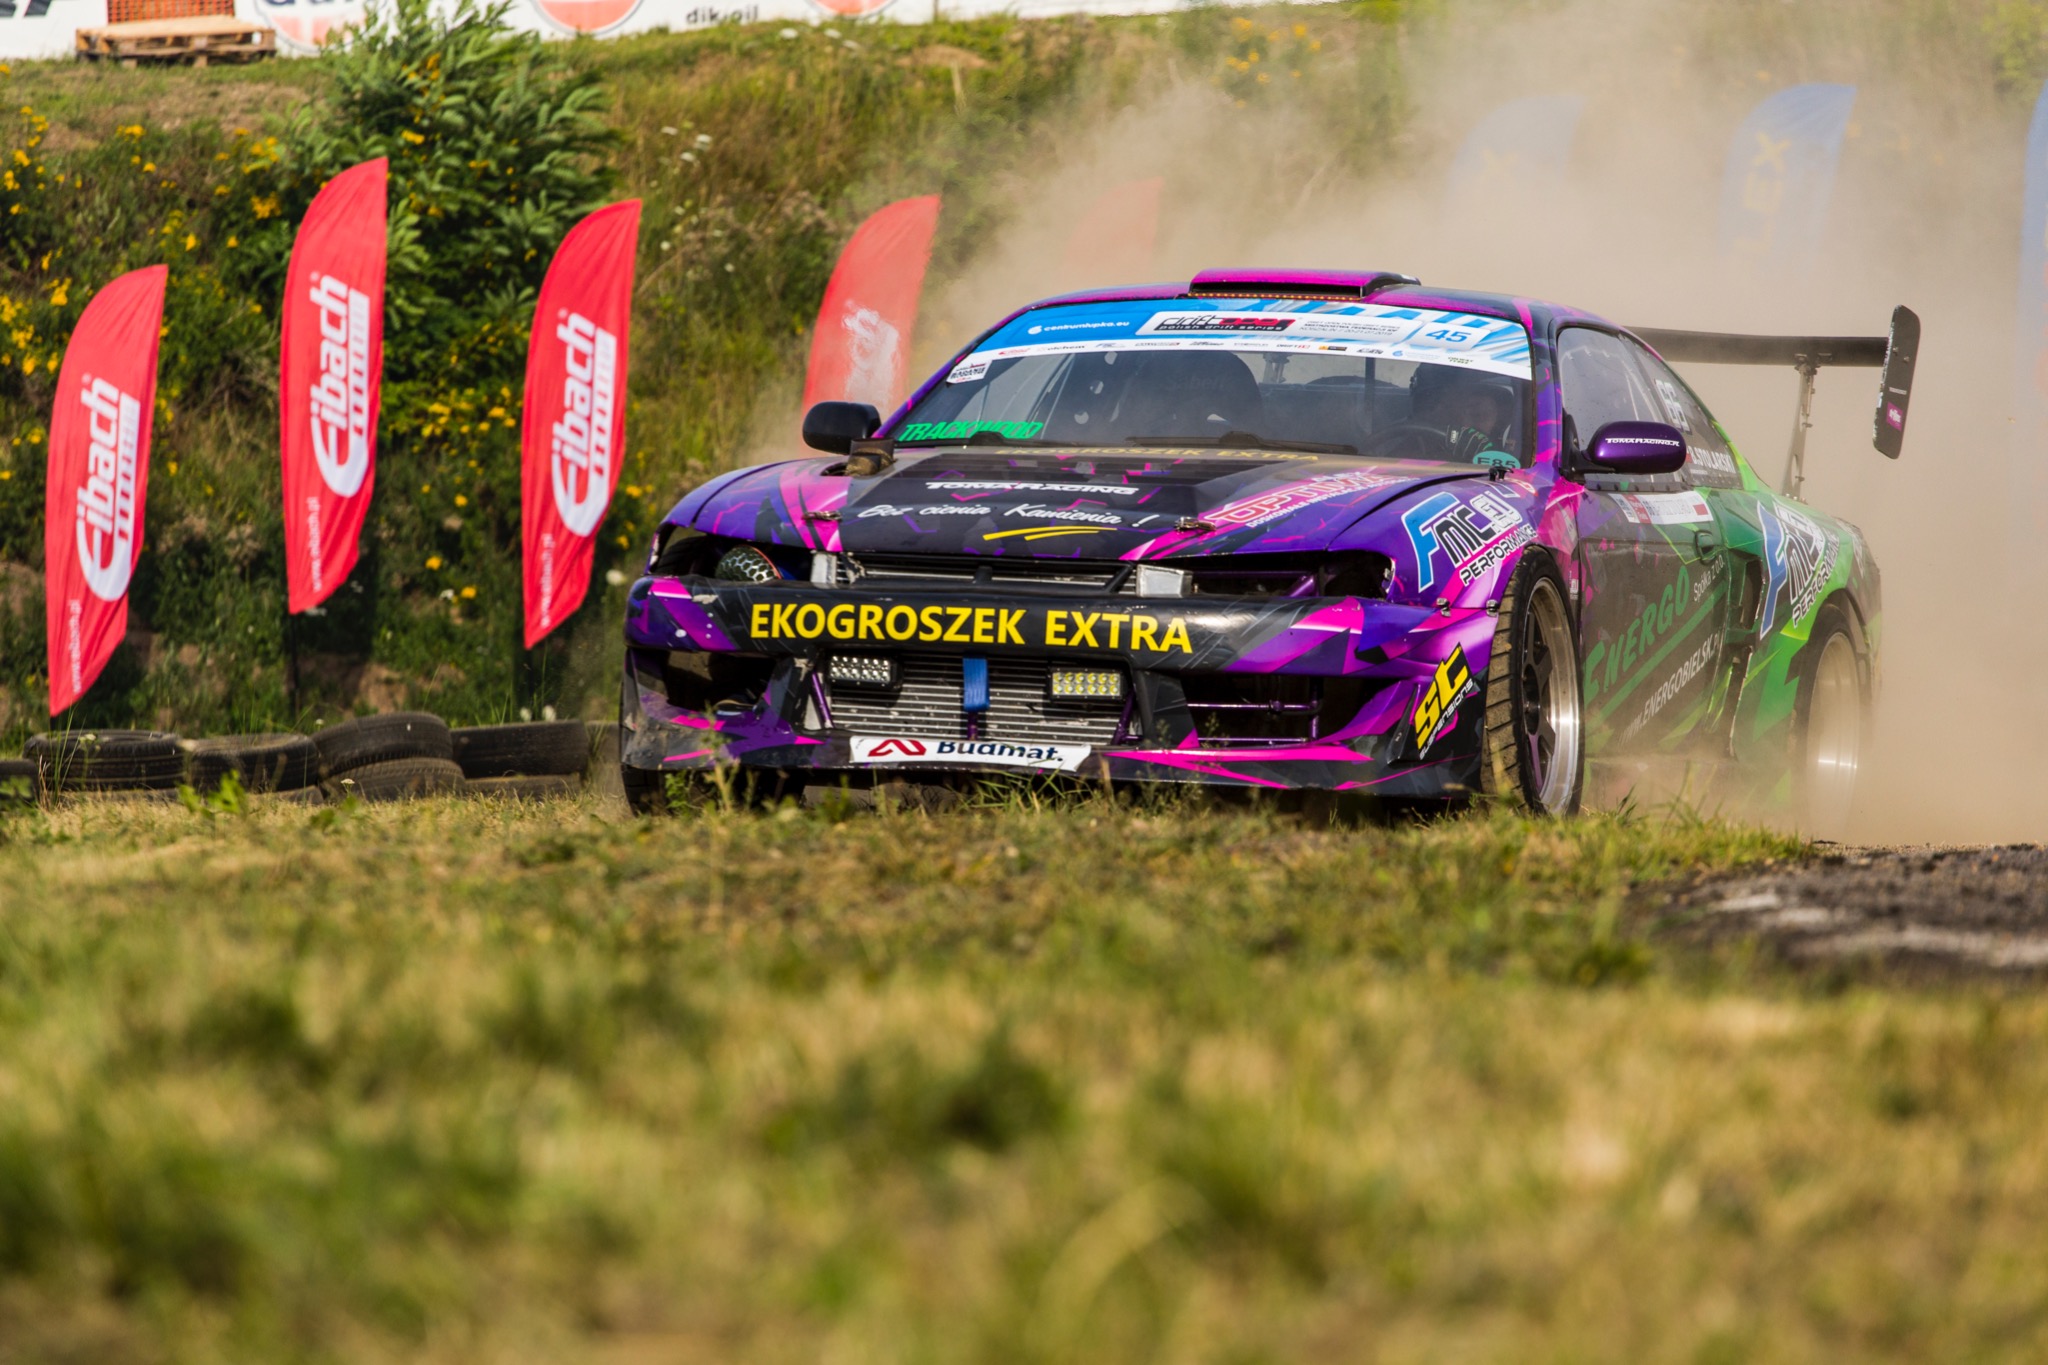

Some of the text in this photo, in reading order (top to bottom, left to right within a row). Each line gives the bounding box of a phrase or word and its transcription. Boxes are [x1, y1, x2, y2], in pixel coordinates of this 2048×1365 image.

[1425, 330, 1472, 343] 45
[310, 273, 369, 497] Eibach
[552, 312, 613, 537] Eibach
[898, 421, 1044, 442] TRACKWOOD
[1217, 450, 1319, 461] EXTRA
[1477, 457, 1517, 469] E85
[77, 377, 137, 602] Eibach
[924, 481, 1140, 496] TOMARACING
[857, 504, 914, 519] Bez
[919, 504, 992, 516] cienia
[1003, 503, 1123, 526] Kamienia
[1459, 523, 1538, 588] PERFORMANCE
[750, 603, 1194, 654] EKOGROSZEK EXTRA
[1583, 565, 1690, 707] ENERGO
[1420, 678, 1474, 761] suspensions
